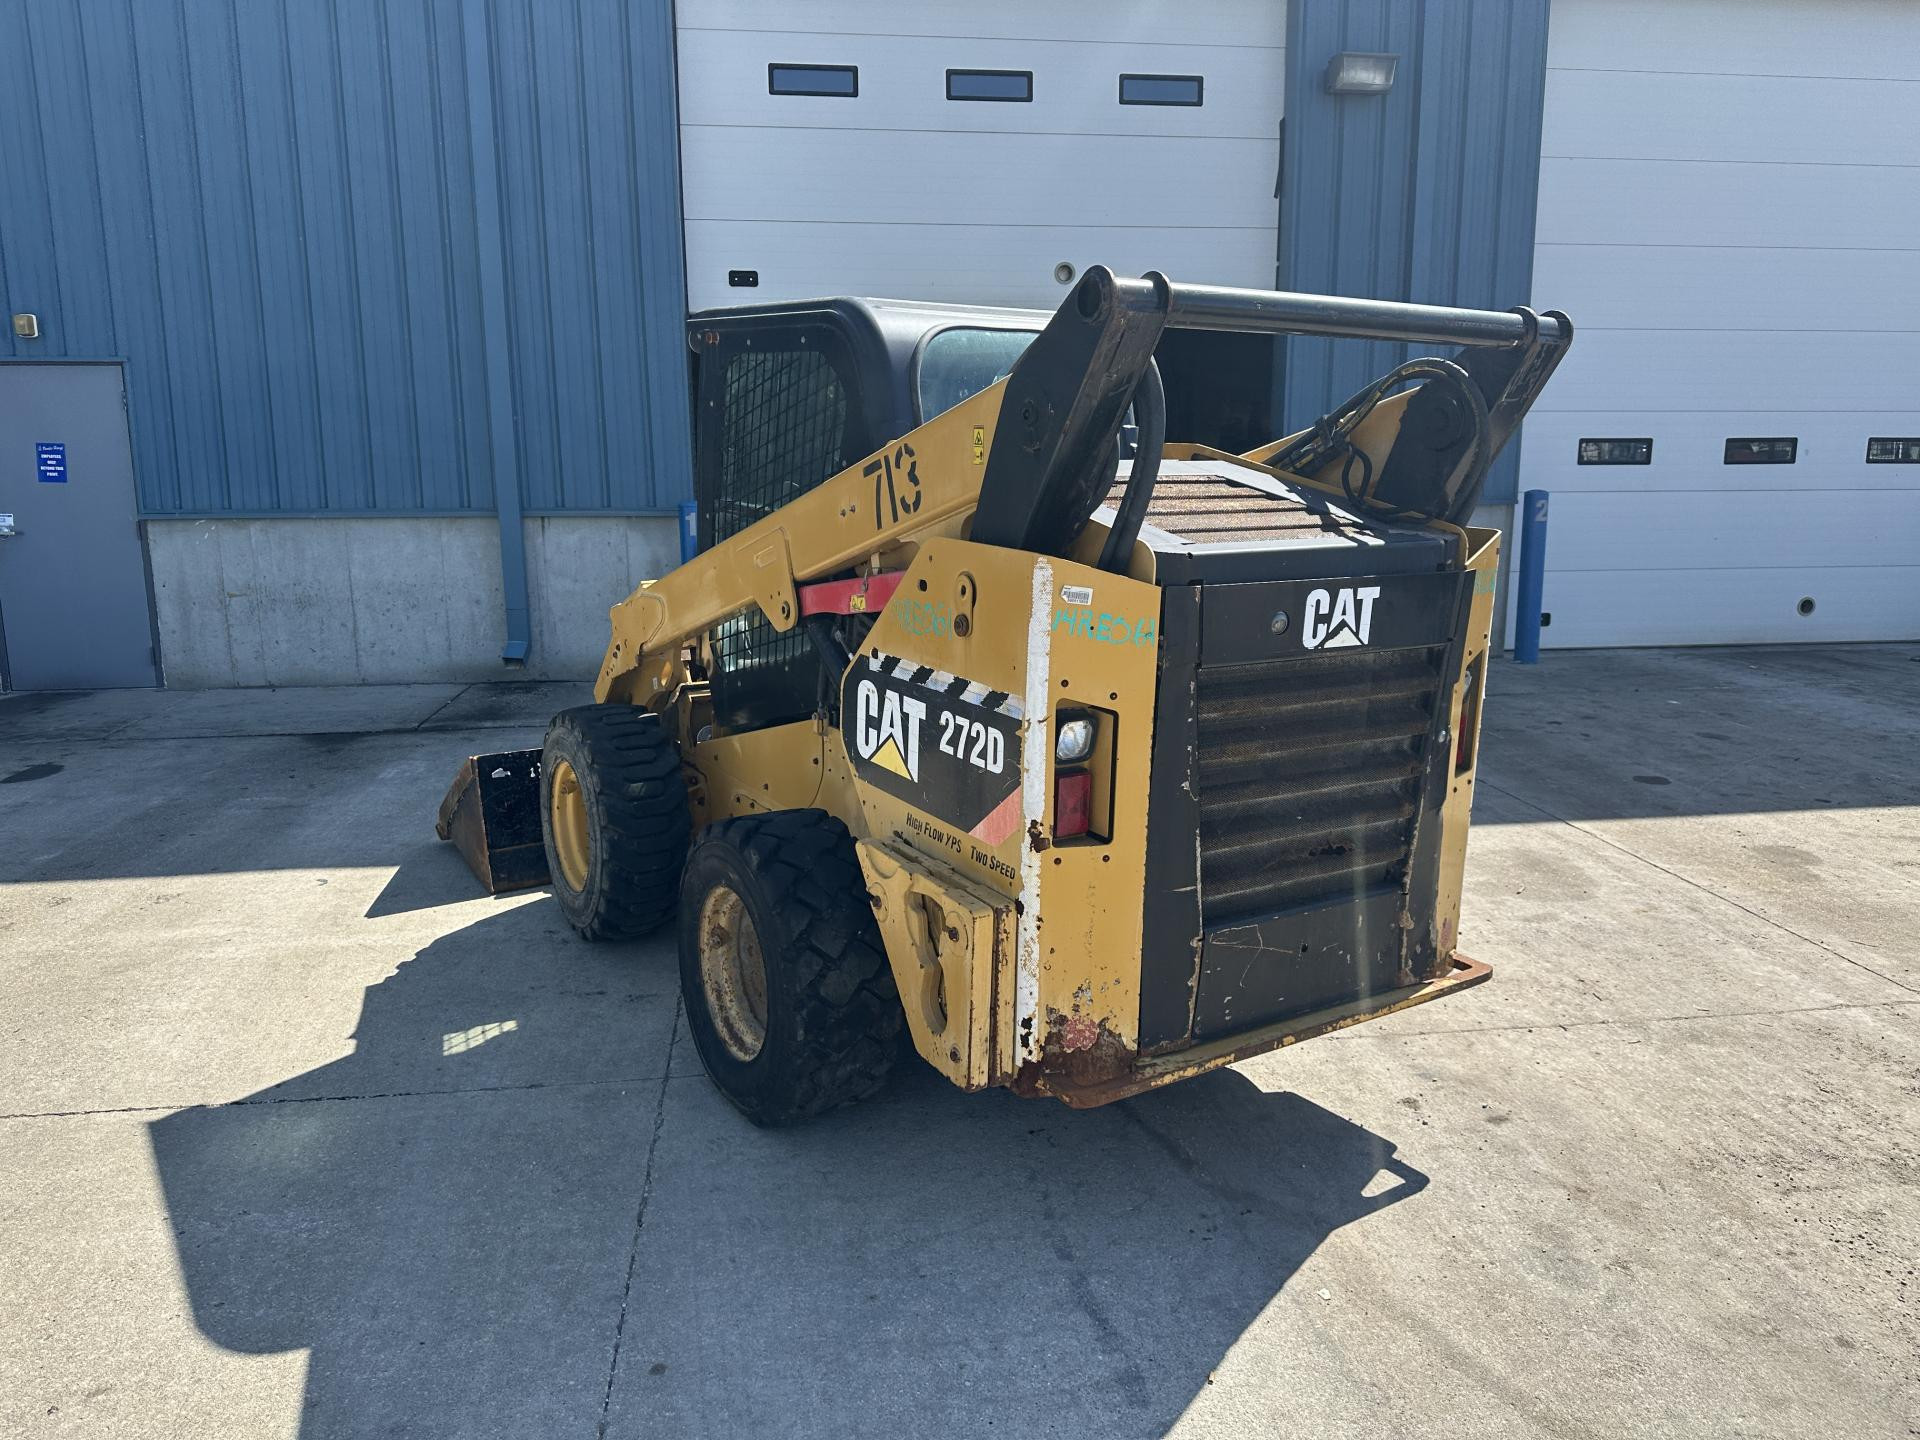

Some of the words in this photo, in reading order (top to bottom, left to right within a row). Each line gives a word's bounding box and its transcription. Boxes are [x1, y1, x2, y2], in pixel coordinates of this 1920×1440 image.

[863, 443, 921, 530] 713
[1535, 500, 1549, 521] 2
[685, 512, 697, 536] 1
[1302, 586, 1381, 650] CAT
[856, 679, 927, 784] CAT
[939, 710, 1005, 774] 272D
[906, 812, 923, 833] HIGH
[924, 822, 945, 843] FLOW
[970, 845, 988, 866] TWO
[989, 855, 1016, 880] SPEED
